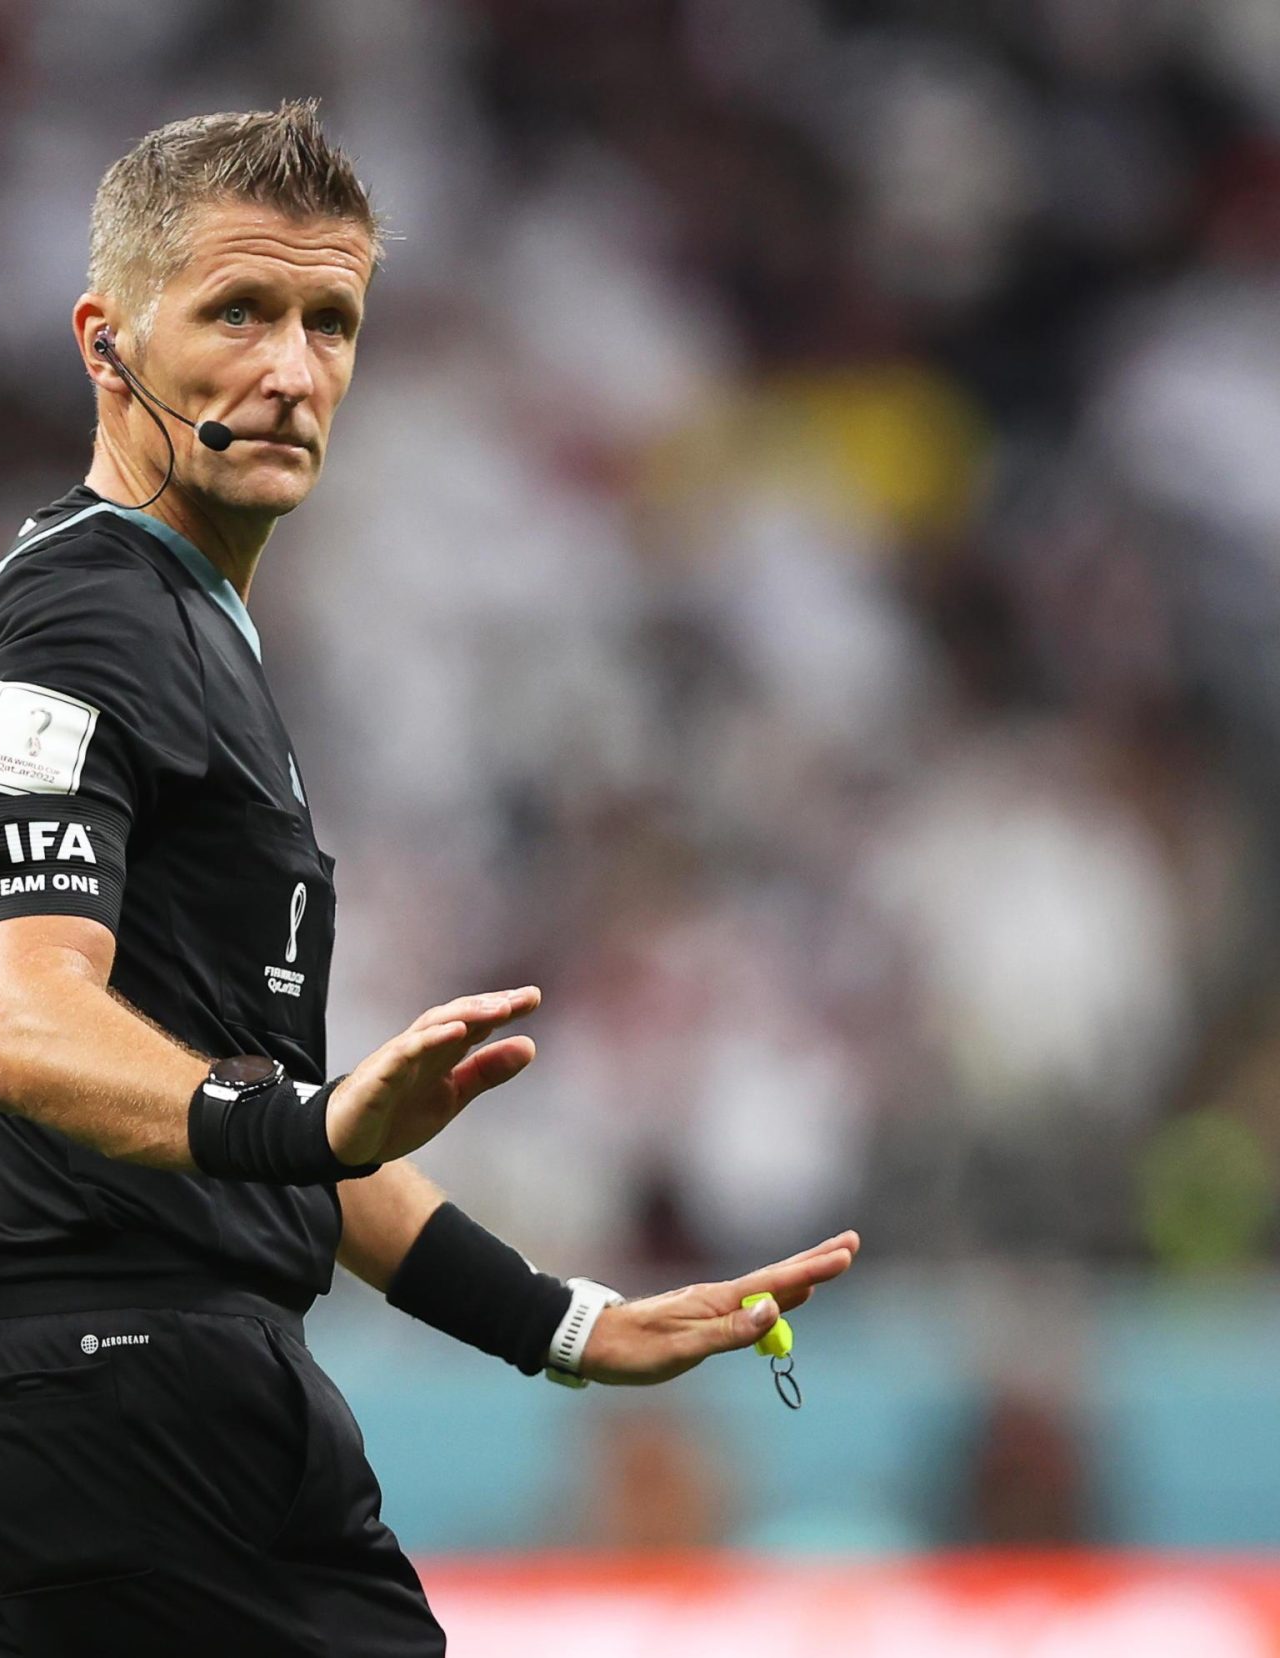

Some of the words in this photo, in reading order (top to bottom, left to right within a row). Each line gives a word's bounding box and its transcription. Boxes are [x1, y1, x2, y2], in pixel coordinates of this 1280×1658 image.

[14, 758, 44, 770] WORLD
[52, 873, 99, 895] ONE
[101, 1335, 149, 1348] AEROREADY
